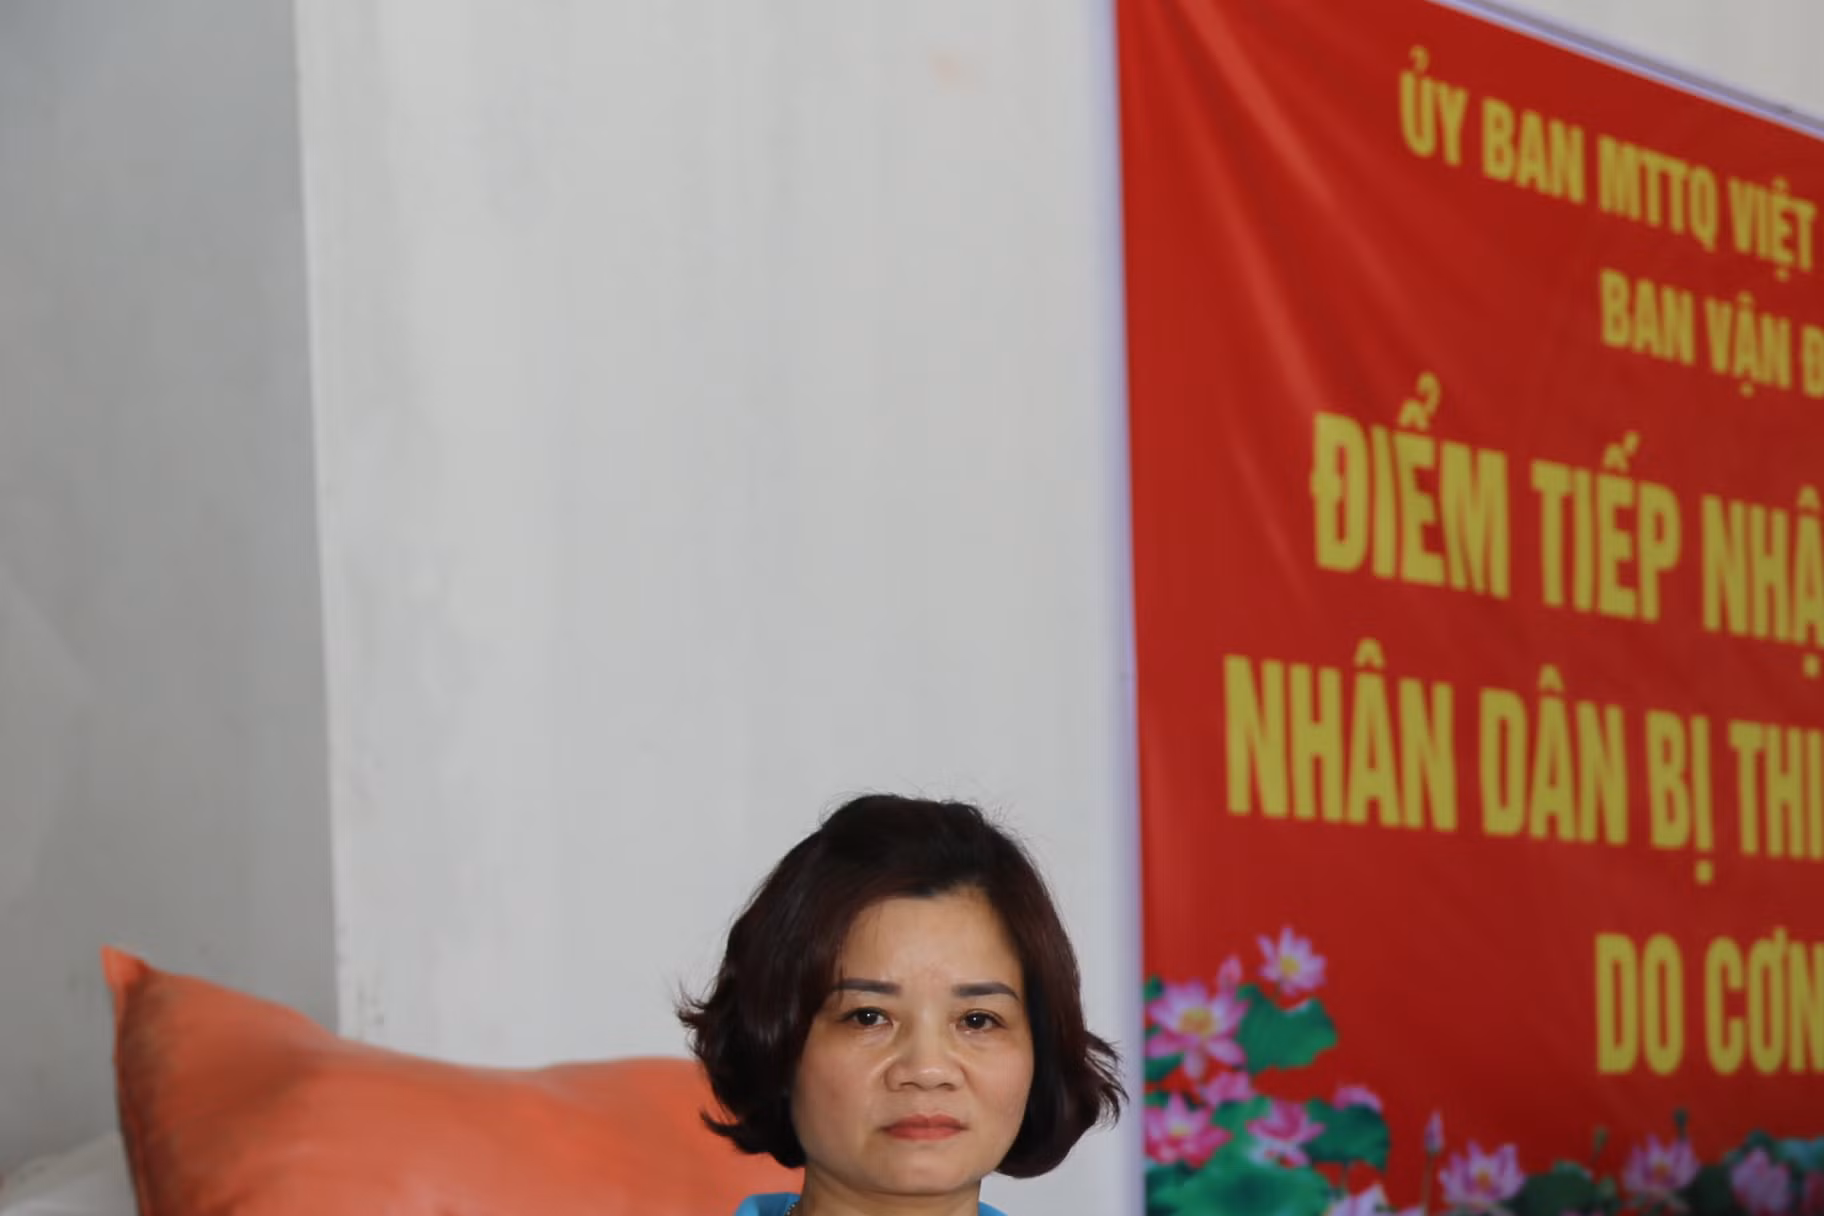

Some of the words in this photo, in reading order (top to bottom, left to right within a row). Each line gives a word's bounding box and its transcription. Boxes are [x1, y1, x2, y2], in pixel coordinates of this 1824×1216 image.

[1400, 45, 1468, 166] ỦY
[1483, 97, 1586, 204] BAN
[1598, 134, 1718, 253] MTTQ
[1729, 177, 1817, 281] VIỆT
[1600, 267, 1694, 352] BAN
[1705, 291, 1791, 397] VẬN
[1311, 372, 1510, 600] ĐIỂM
[1531, 431, 1682, 622] TIẾP
[1224, 637, 1457, 832] NHÂN
[1479, 663, 1629, 846] DÂN
[1645, 708, 1713, 885] BỊ
[1596, 931, 1684, 1076] DO
